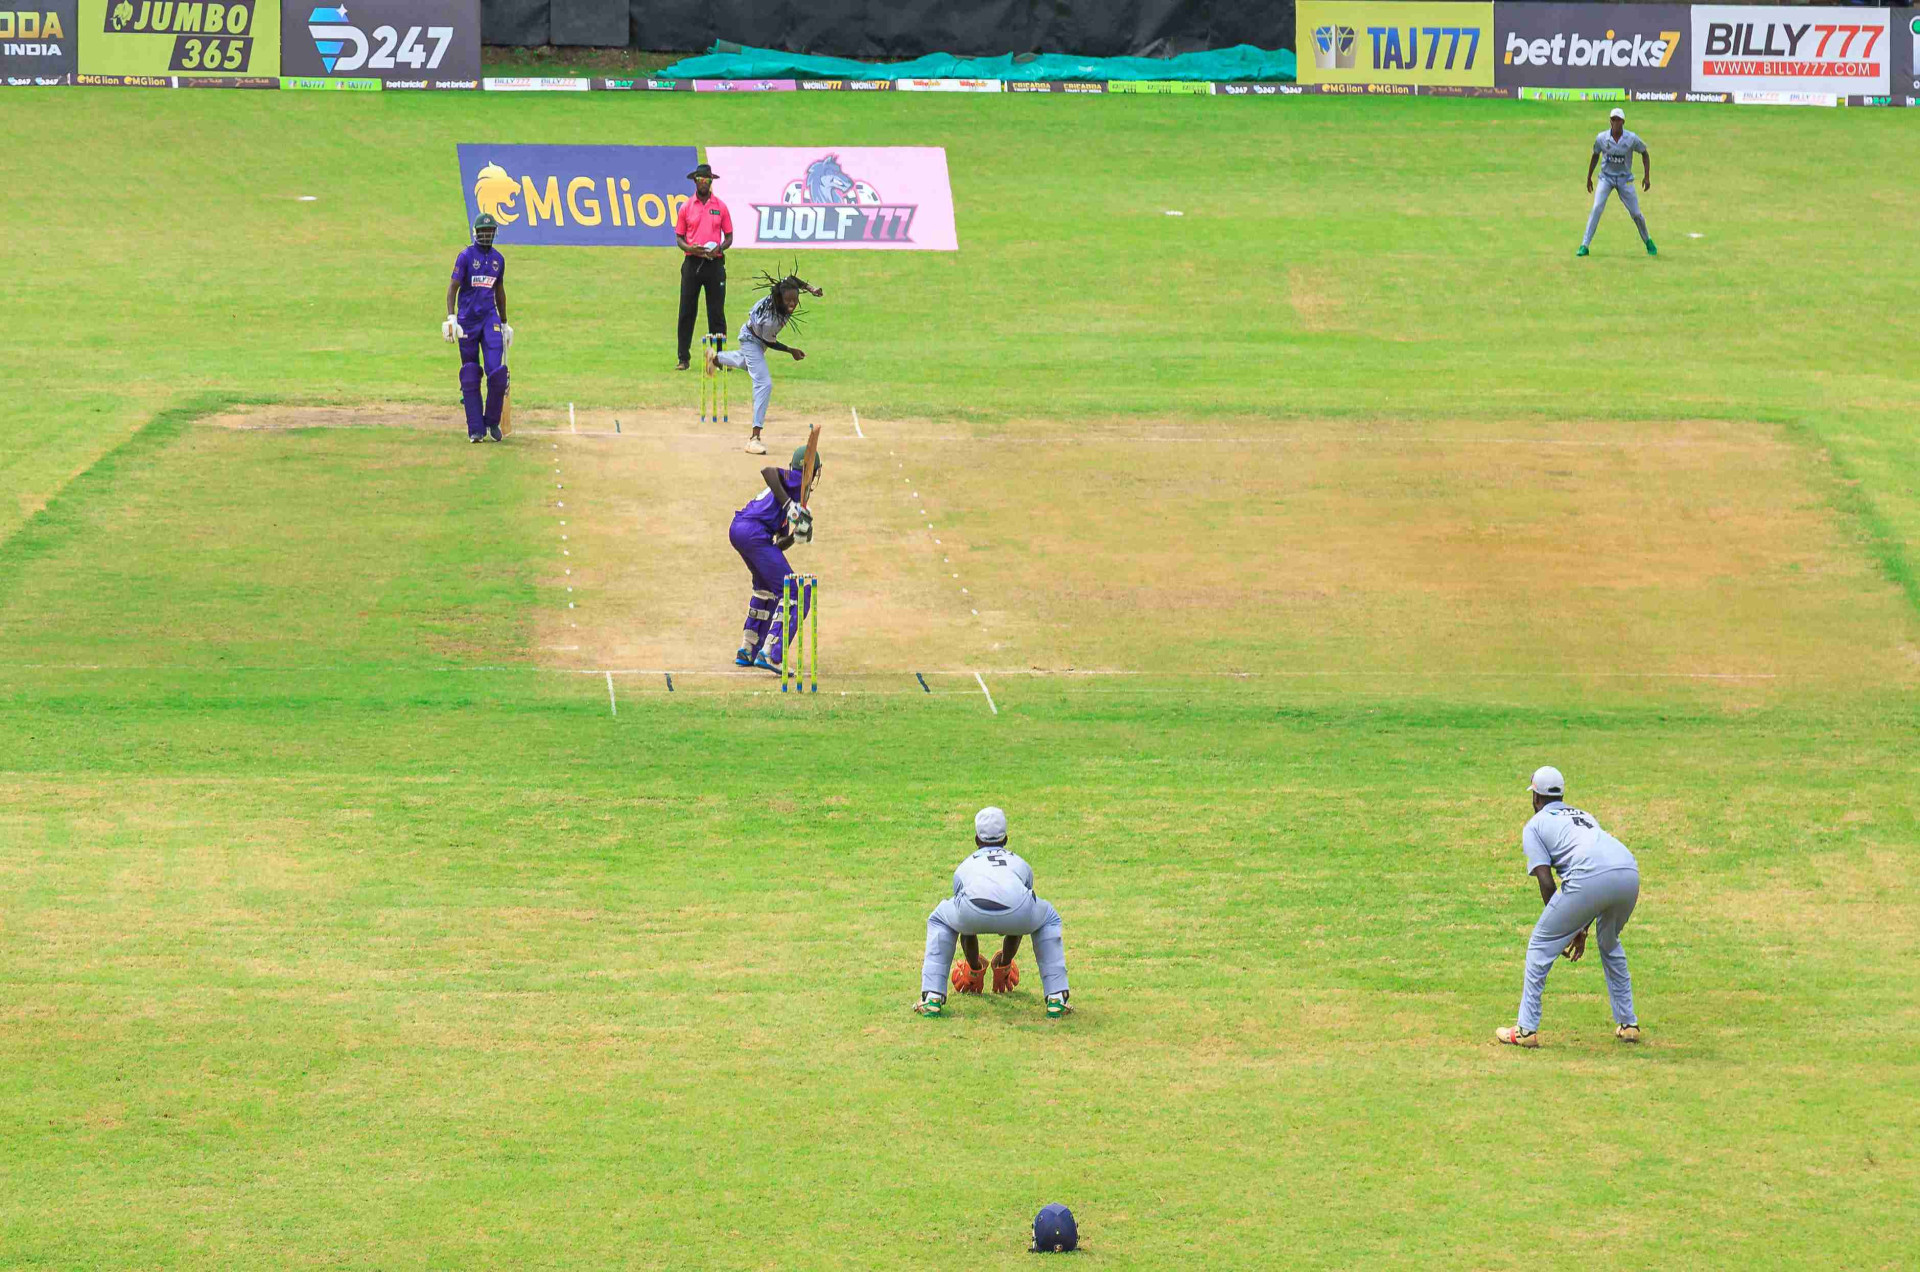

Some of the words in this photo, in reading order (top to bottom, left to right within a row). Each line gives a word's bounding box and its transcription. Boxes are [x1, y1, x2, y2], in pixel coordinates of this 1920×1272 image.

[134, 1, 249, 34] JUMBO
[4, 44, 62, 56] INDIA
[181, 39, 244, 69] 365
[1713, 62, 1871, 76] WWW.BILLY777.COM
